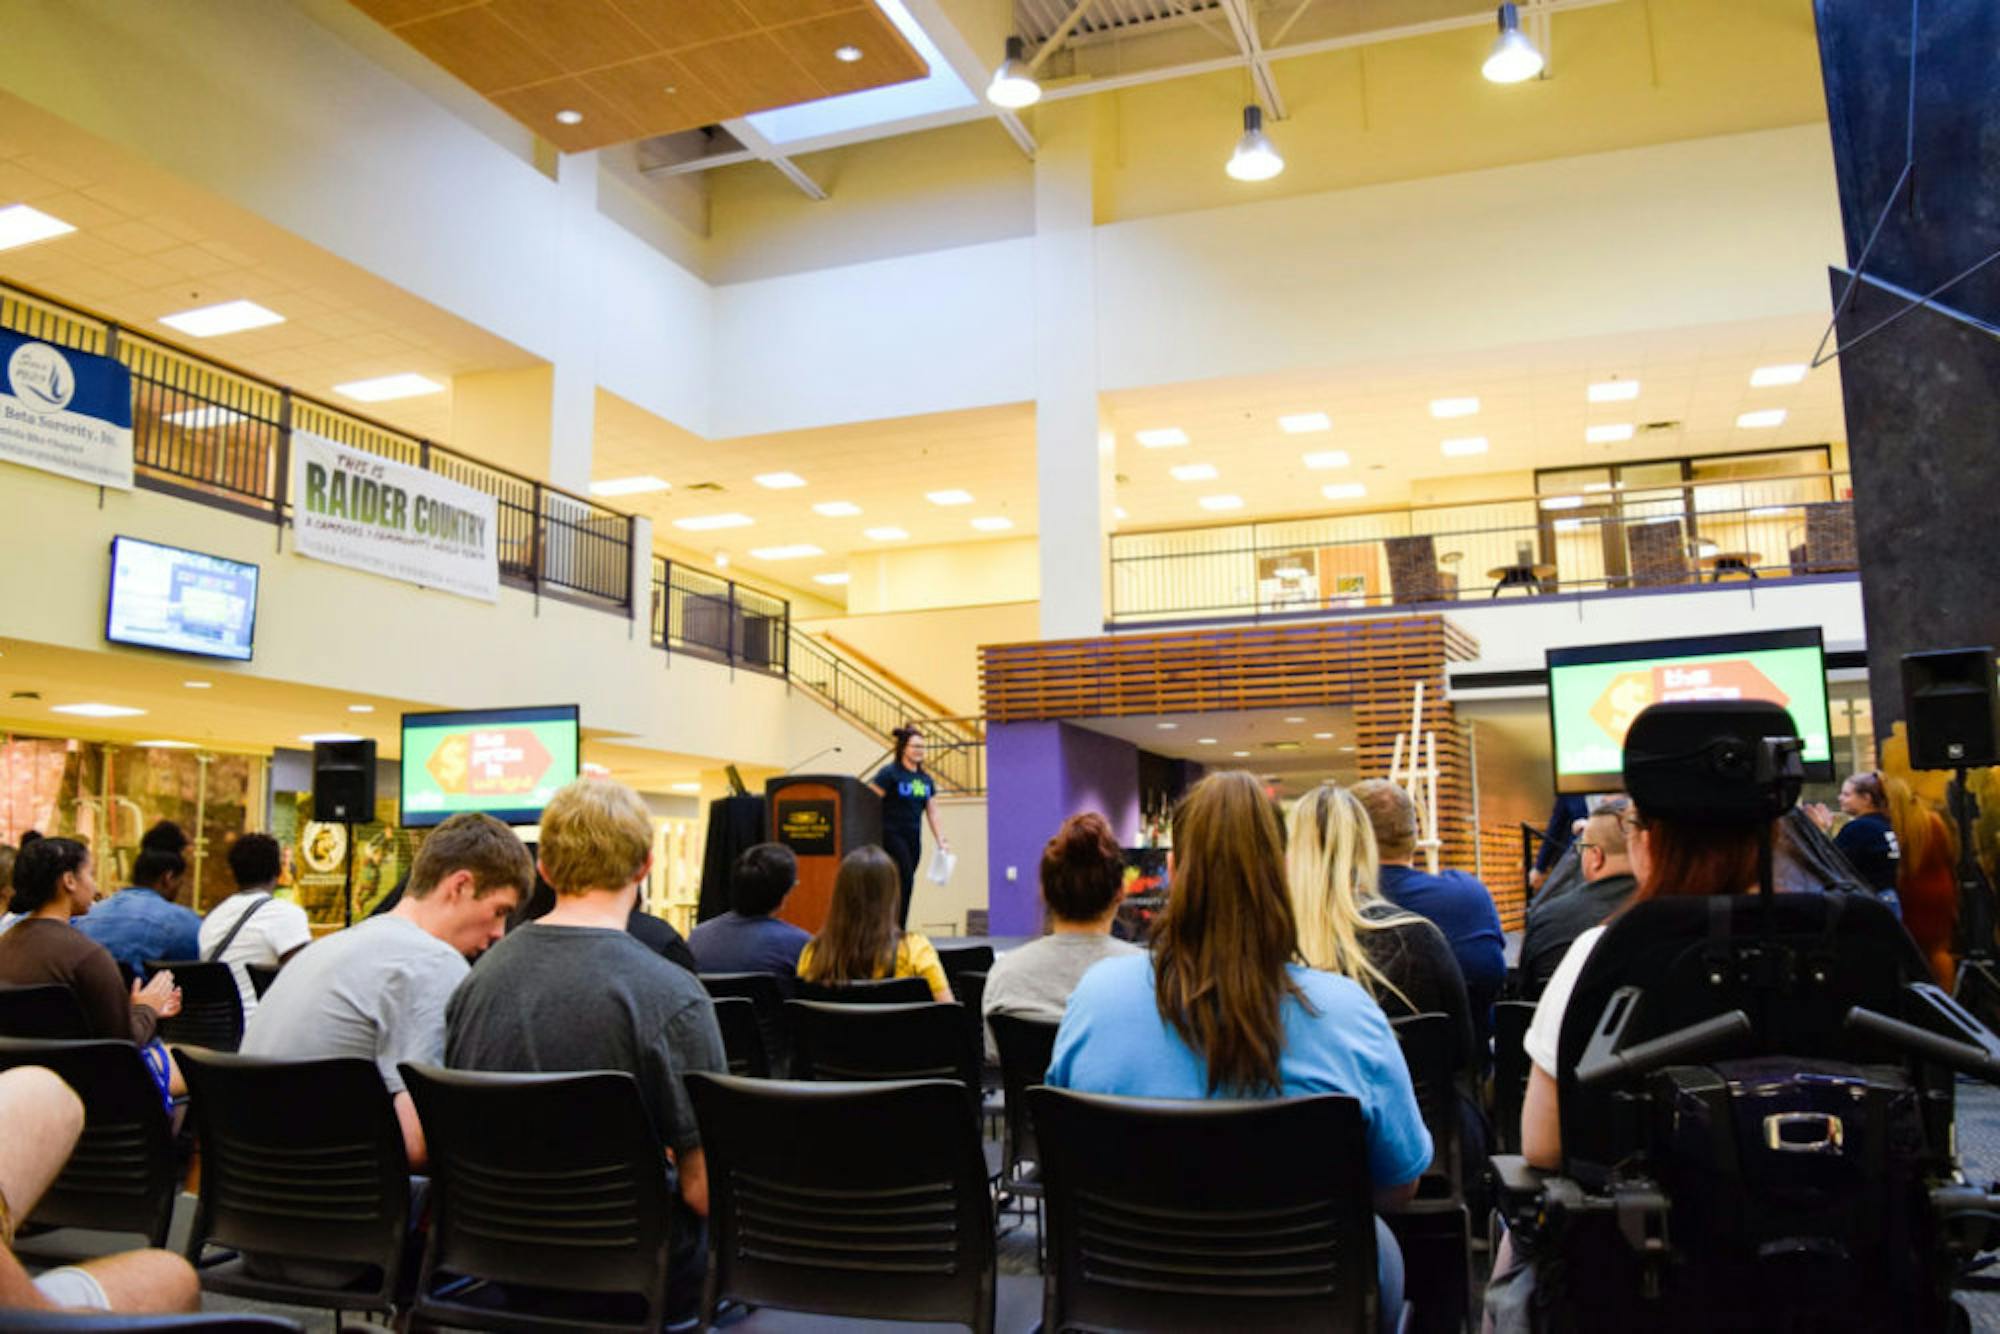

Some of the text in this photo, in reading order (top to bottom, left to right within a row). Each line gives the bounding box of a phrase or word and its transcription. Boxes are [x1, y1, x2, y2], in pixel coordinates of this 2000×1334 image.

[338, 454, 384, 479] THIS IS
[305, 461, 486, 548] RAIDER COUNTRY
